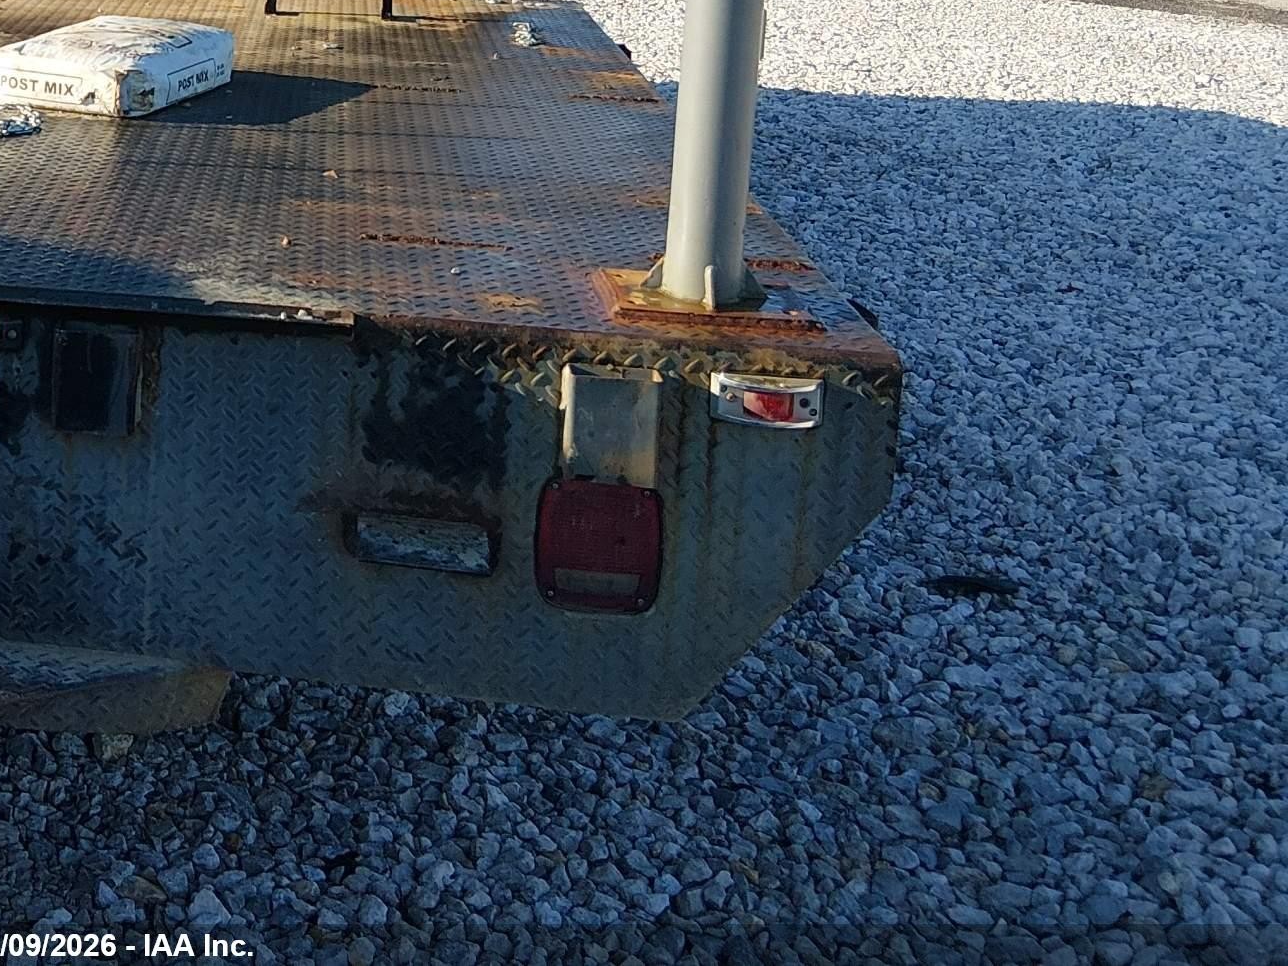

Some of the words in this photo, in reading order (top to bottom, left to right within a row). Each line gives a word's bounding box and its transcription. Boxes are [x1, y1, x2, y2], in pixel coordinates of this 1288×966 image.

[0, 74, 40, 92] POST
[44, 80, 76, 97] MIX
[178, 75, 195, 92] POST
[196, 70, 209, 84] MIX
